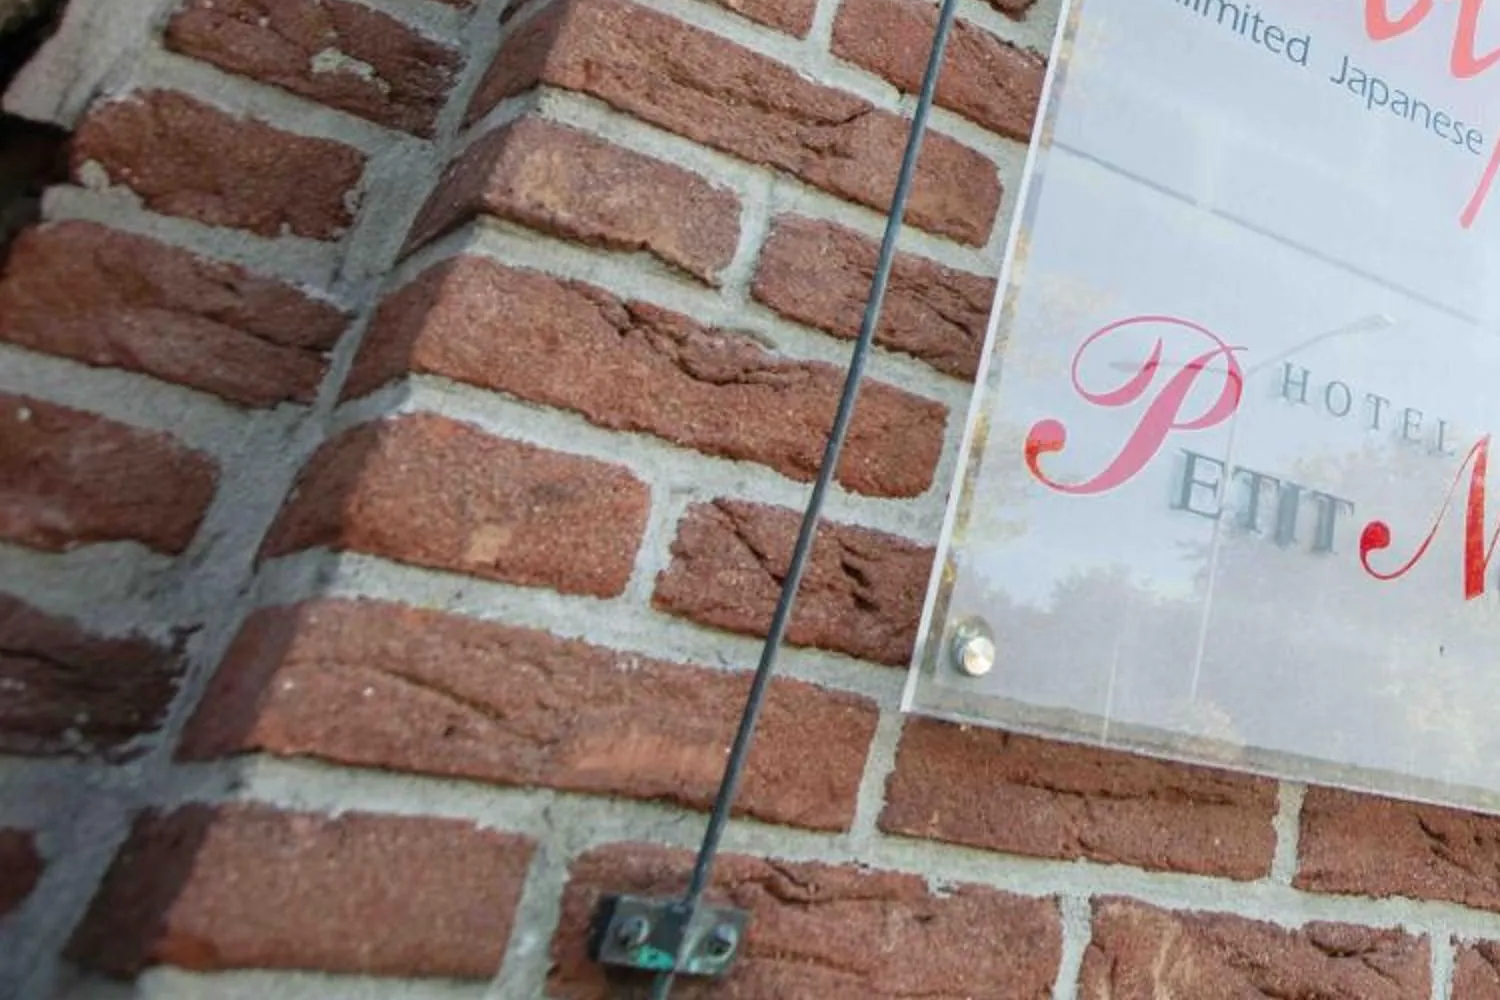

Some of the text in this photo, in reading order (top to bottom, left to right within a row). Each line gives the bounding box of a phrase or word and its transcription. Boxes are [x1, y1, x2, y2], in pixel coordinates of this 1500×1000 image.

[1330, 55, 1484, 156] Japanese
[1025, 315, 1355, 556] PETIT
[1279, 361, 1456, 458] HOTEL
